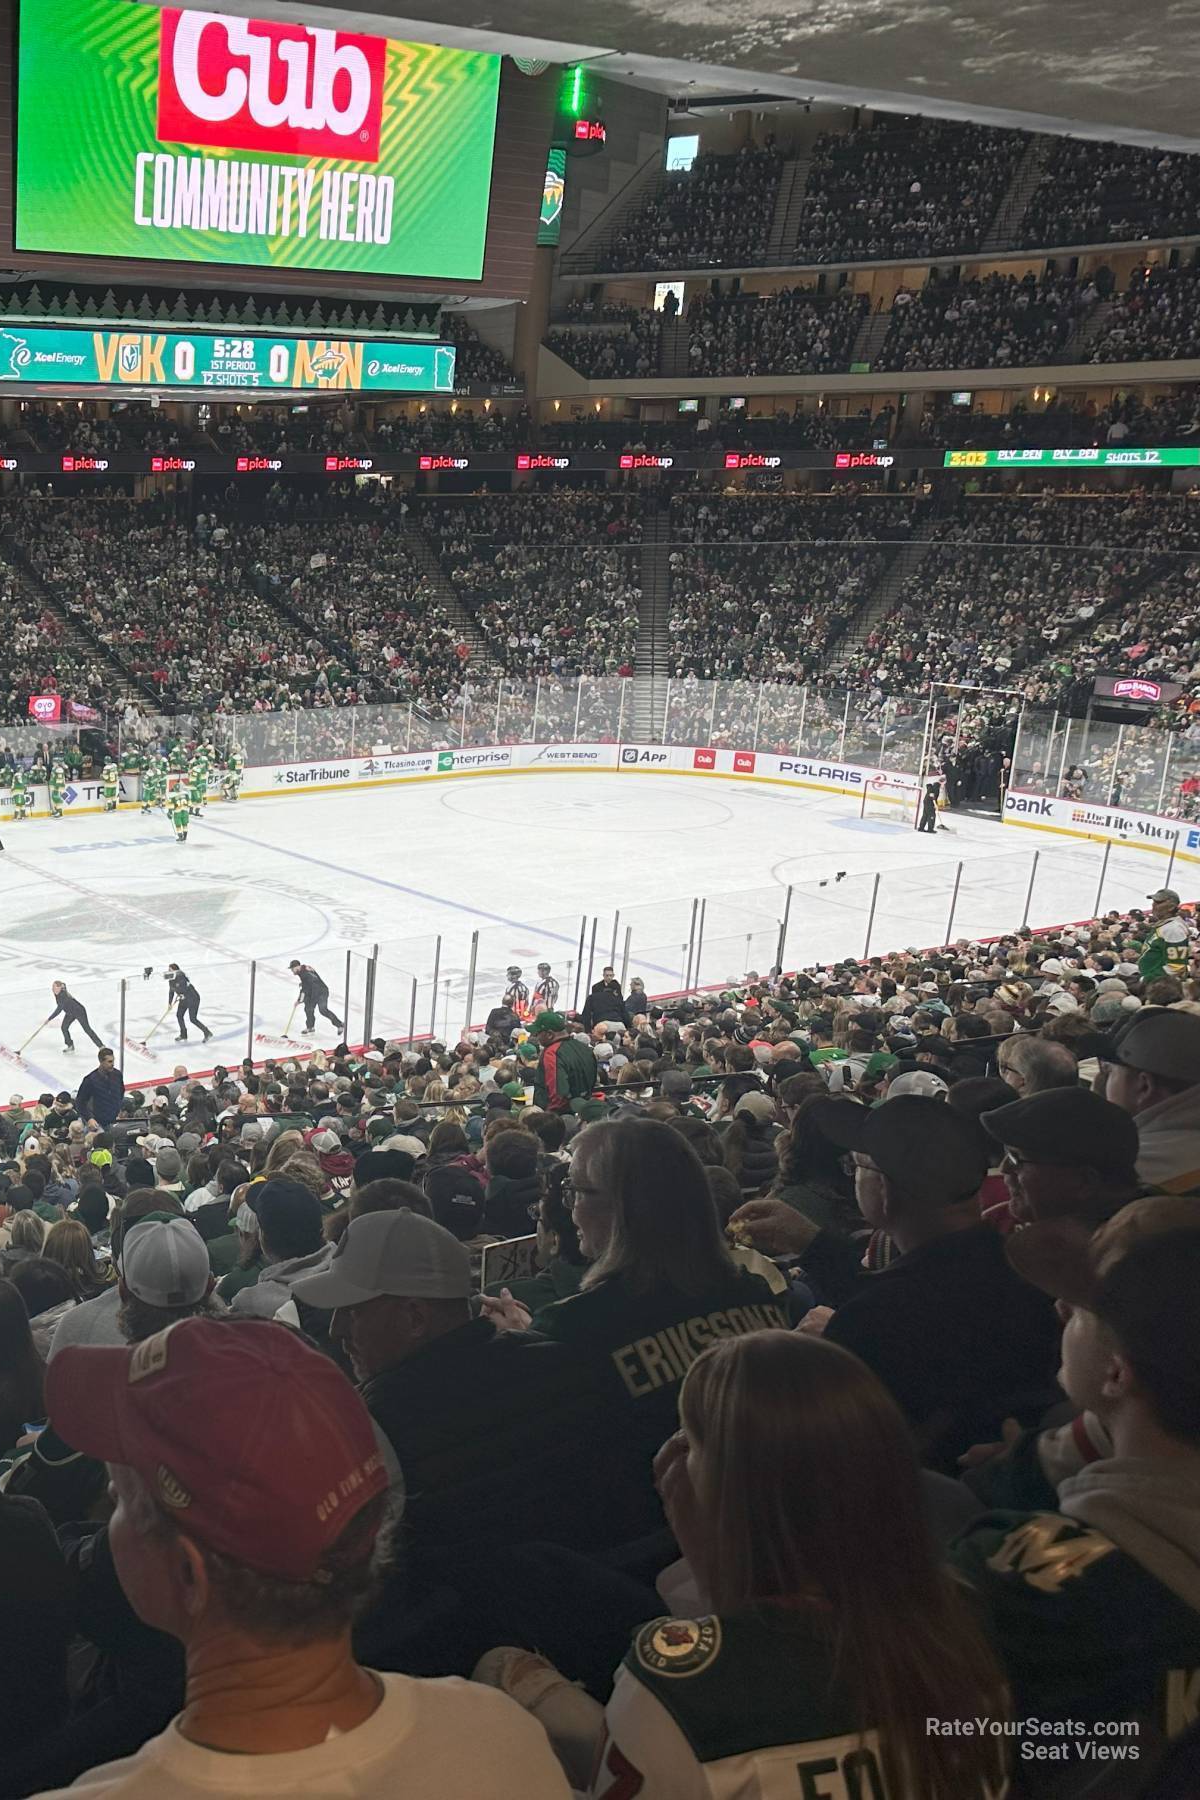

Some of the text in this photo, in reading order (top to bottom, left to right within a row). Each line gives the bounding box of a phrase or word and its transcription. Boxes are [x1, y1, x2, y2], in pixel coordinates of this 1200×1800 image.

[173, 10, 371, 136] Cub
[134, 152, 395, 245] COMMUNITY HERO
[213, 339, 255, 359] 5:28
[93, 333, 166, 382] VGK
[174, 341, 195, 381] 0
[225, 360, 256, 370] PERIOD
[269, 344, 290, 383] 0
[203, 373, 259, 386] 12 SHOTS 5
[75, 456, 108, 471] pickup
[163, 457, 195, 471] pickup
[249, 456, 282, 471] pickup
[339, 456, 373, 470] pickup
[432, 455, 468, 470] pickup
[530, 455, 569, 469] pickup
[633, 454, 673, 469] pickup
[740, 454, 781, 468] pickup
[851, 453, 894, 468] pickup
[949, 452, 987, 466] 3:03
[1105, 453, 1141, 463] SHOTS
[441, 751, 510, 767] enterprise
[697, 755, 712, 764] Cub
[737, 758, 752, 767] Cub
[286, 768, 350, 785] StarTribune
[779, 761, 862, 784] POLARIS
[82, 781, 126, 801] TRA
[1005, 797, 1054, 817] bank
